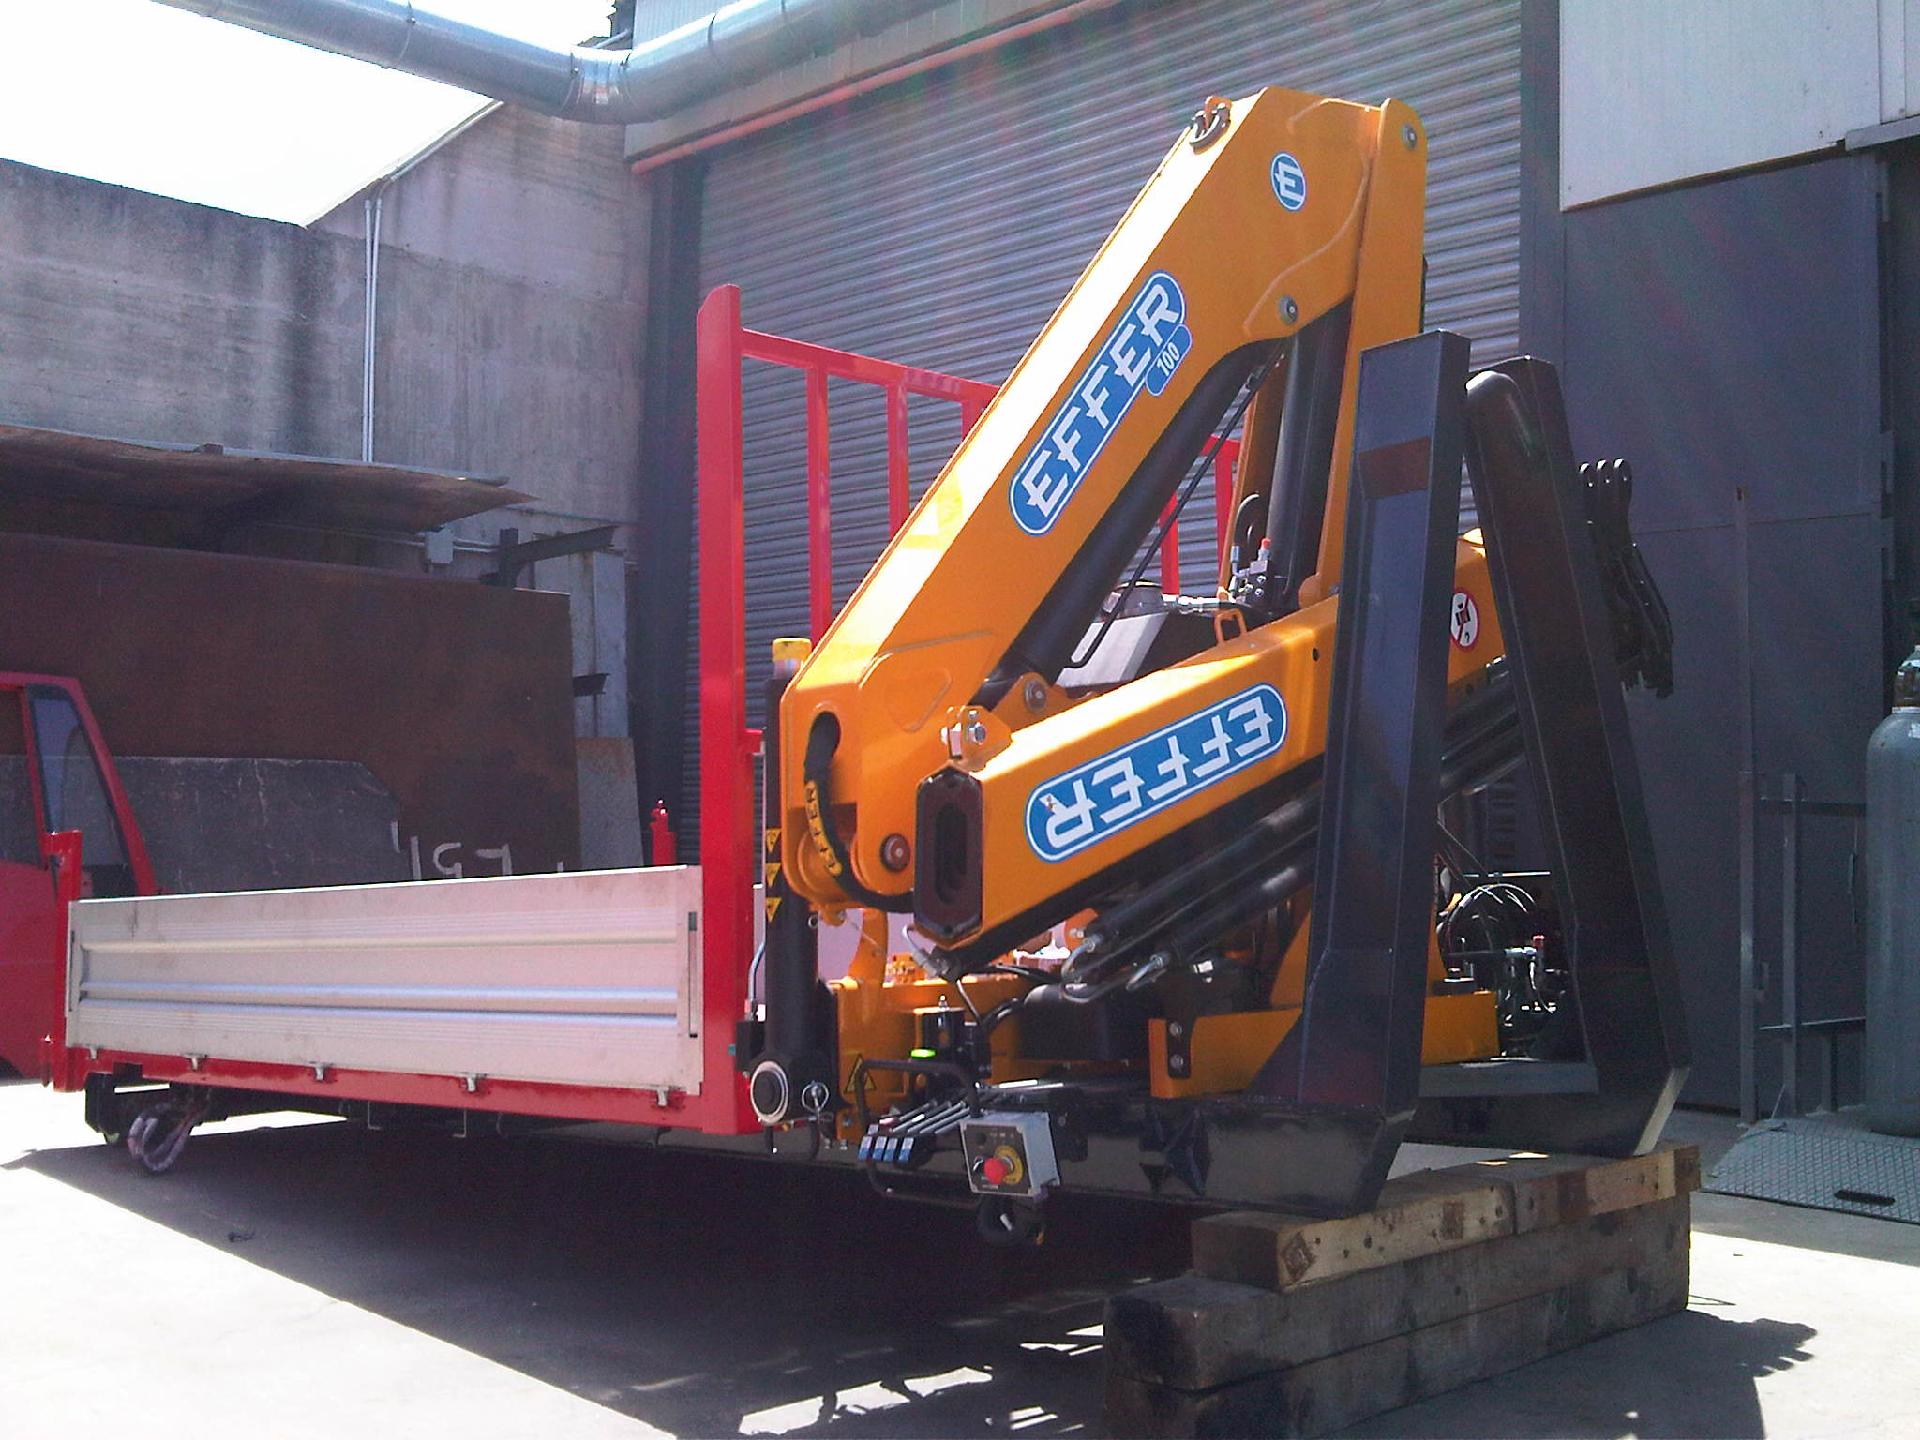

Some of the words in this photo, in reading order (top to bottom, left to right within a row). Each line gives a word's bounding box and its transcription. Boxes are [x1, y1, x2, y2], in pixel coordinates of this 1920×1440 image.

[1021, 284, 1179, 517] EFFER
[1156, 342, 1180, 377] 100
[1040, 696, 1273, 849] EFFER
